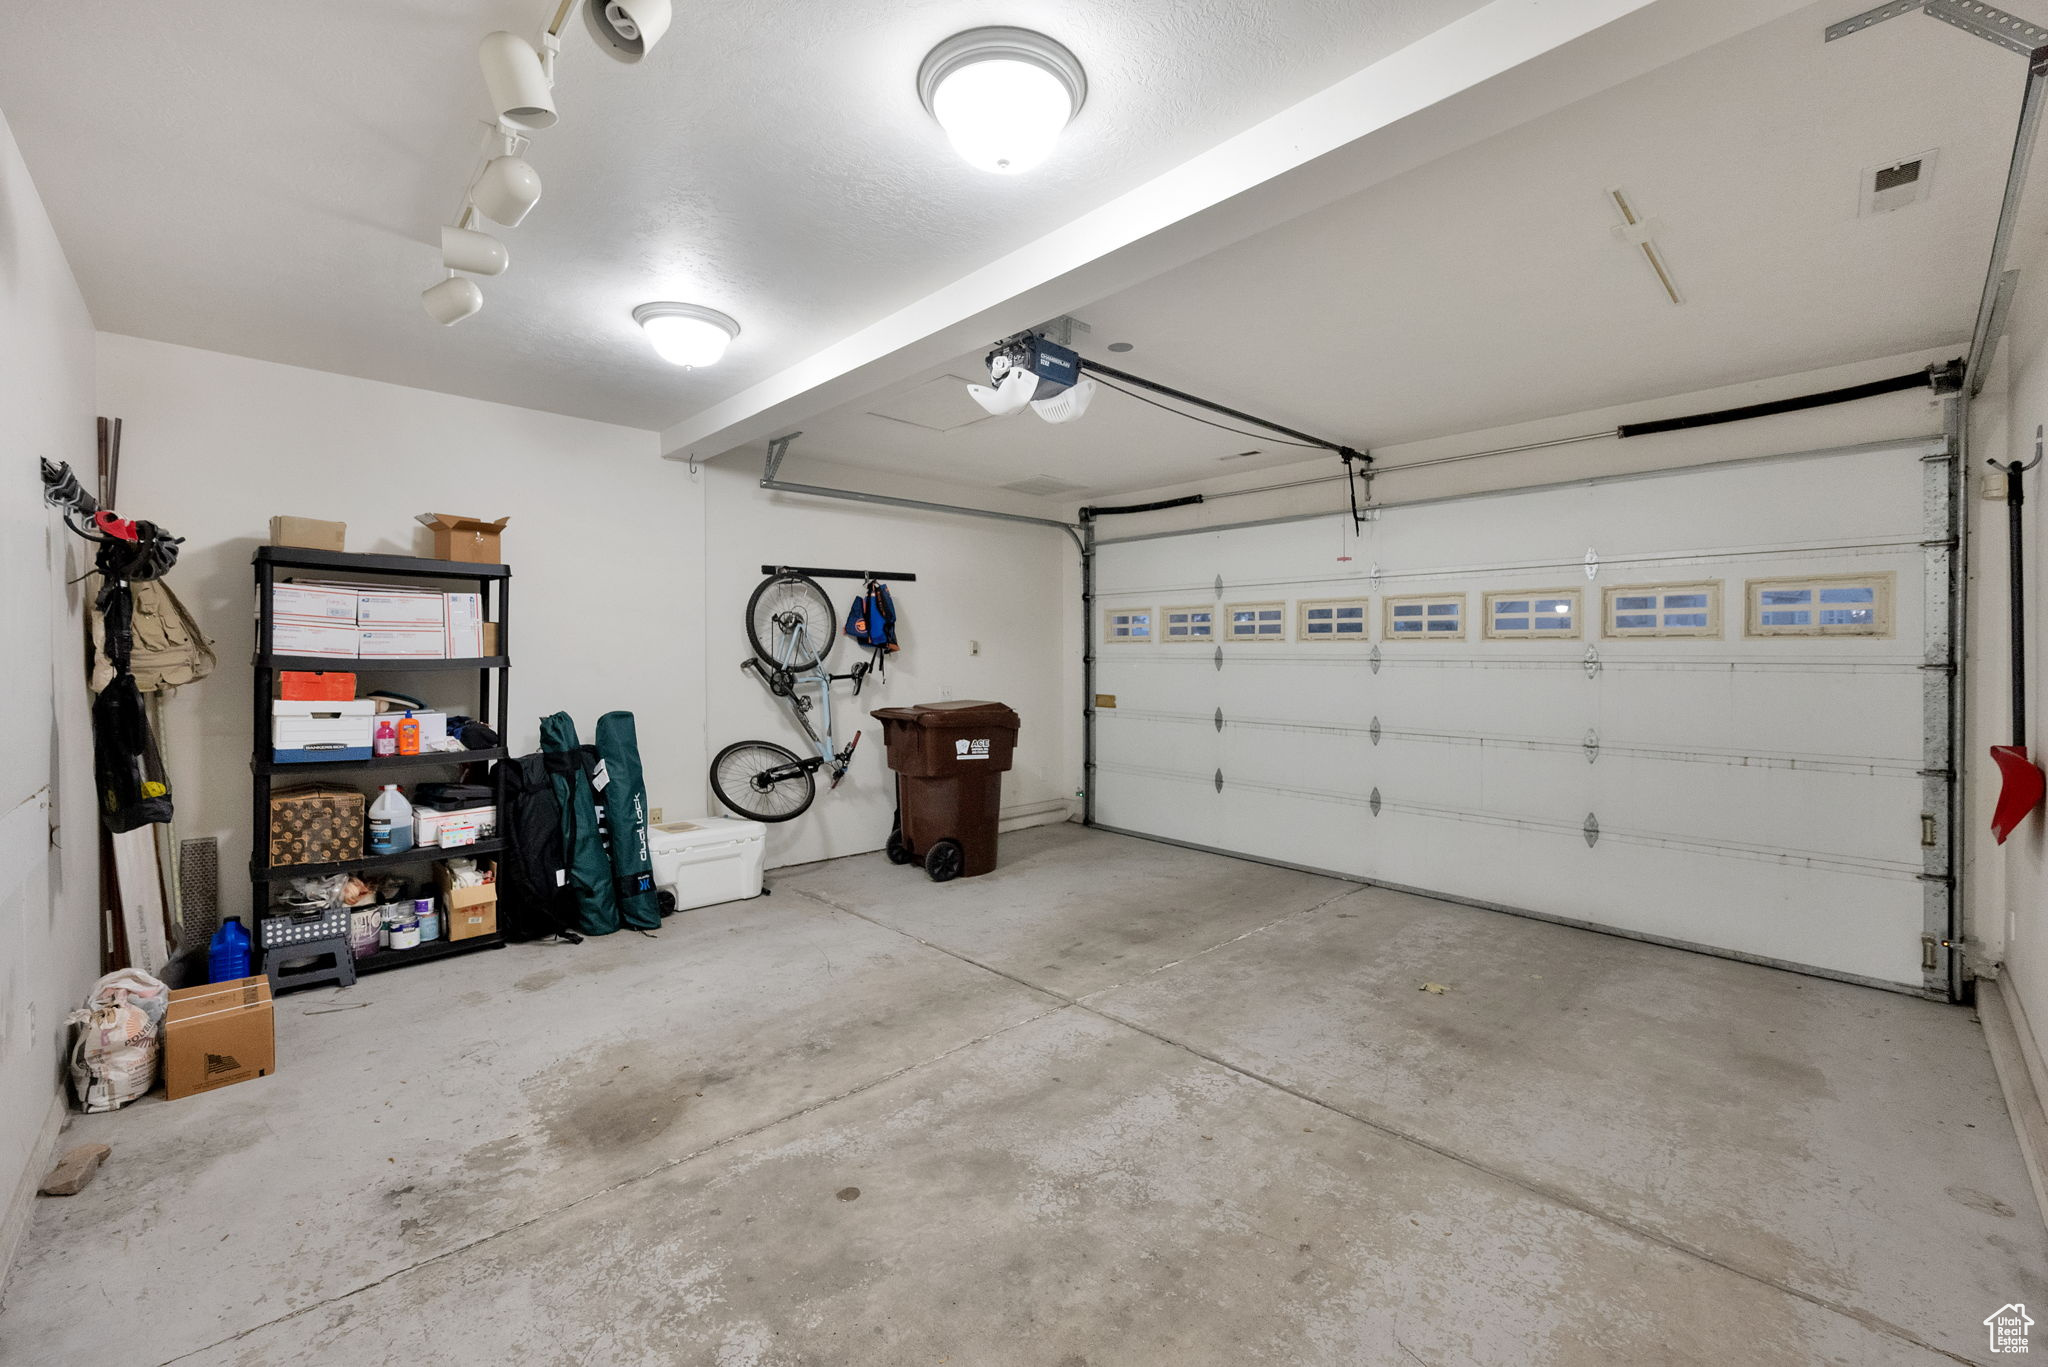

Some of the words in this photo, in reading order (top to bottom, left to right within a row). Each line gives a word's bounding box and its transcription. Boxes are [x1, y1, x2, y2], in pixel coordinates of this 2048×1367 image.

[971, 739, 989, 748] ACE
[633, 792, 644, 825] lock
[637, 826, 648, 861] dual
